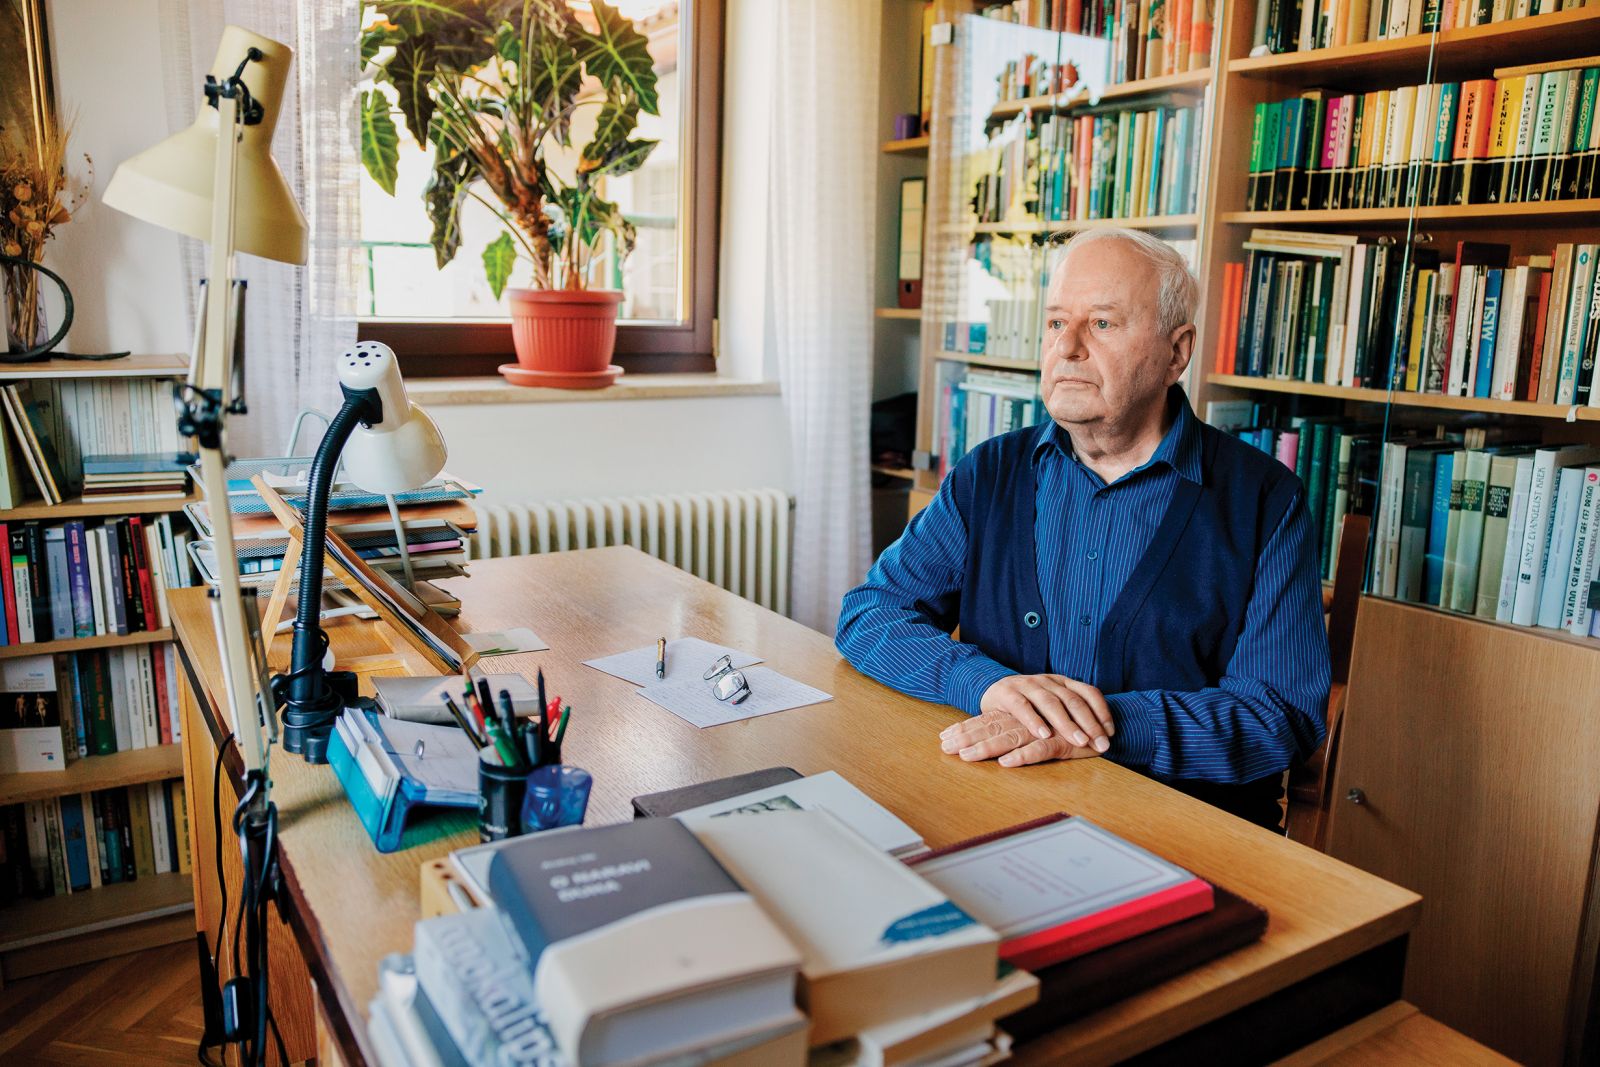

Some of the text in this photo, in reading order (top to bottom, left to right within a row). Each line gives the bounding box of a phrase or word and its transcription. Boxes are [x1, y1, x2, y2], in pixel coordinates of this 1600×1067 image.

[1327, 108, 1339, 160] BRUNO
[1462, 91, 1476, 149] SPENGLER
[1496, 89, 1510, 147] SPENGLER
[1518, 86, 1534, 145] HEIDEGGER
[1540, 83, 1557, 144] HEIDEGGER
[1481, 296, 1498, 342] MISLI
[1569, 284, 1585, 346] FENOMENOLOGIJA
[1525, 466, 1546, 569] JANEZ EVANGELIST KREK
[1575, 535, 1586, 566] GOSPODA
[1584, 485, 1594, 508] DROGO
[1577, 586, 1589, 625] DIALEKTIKA
